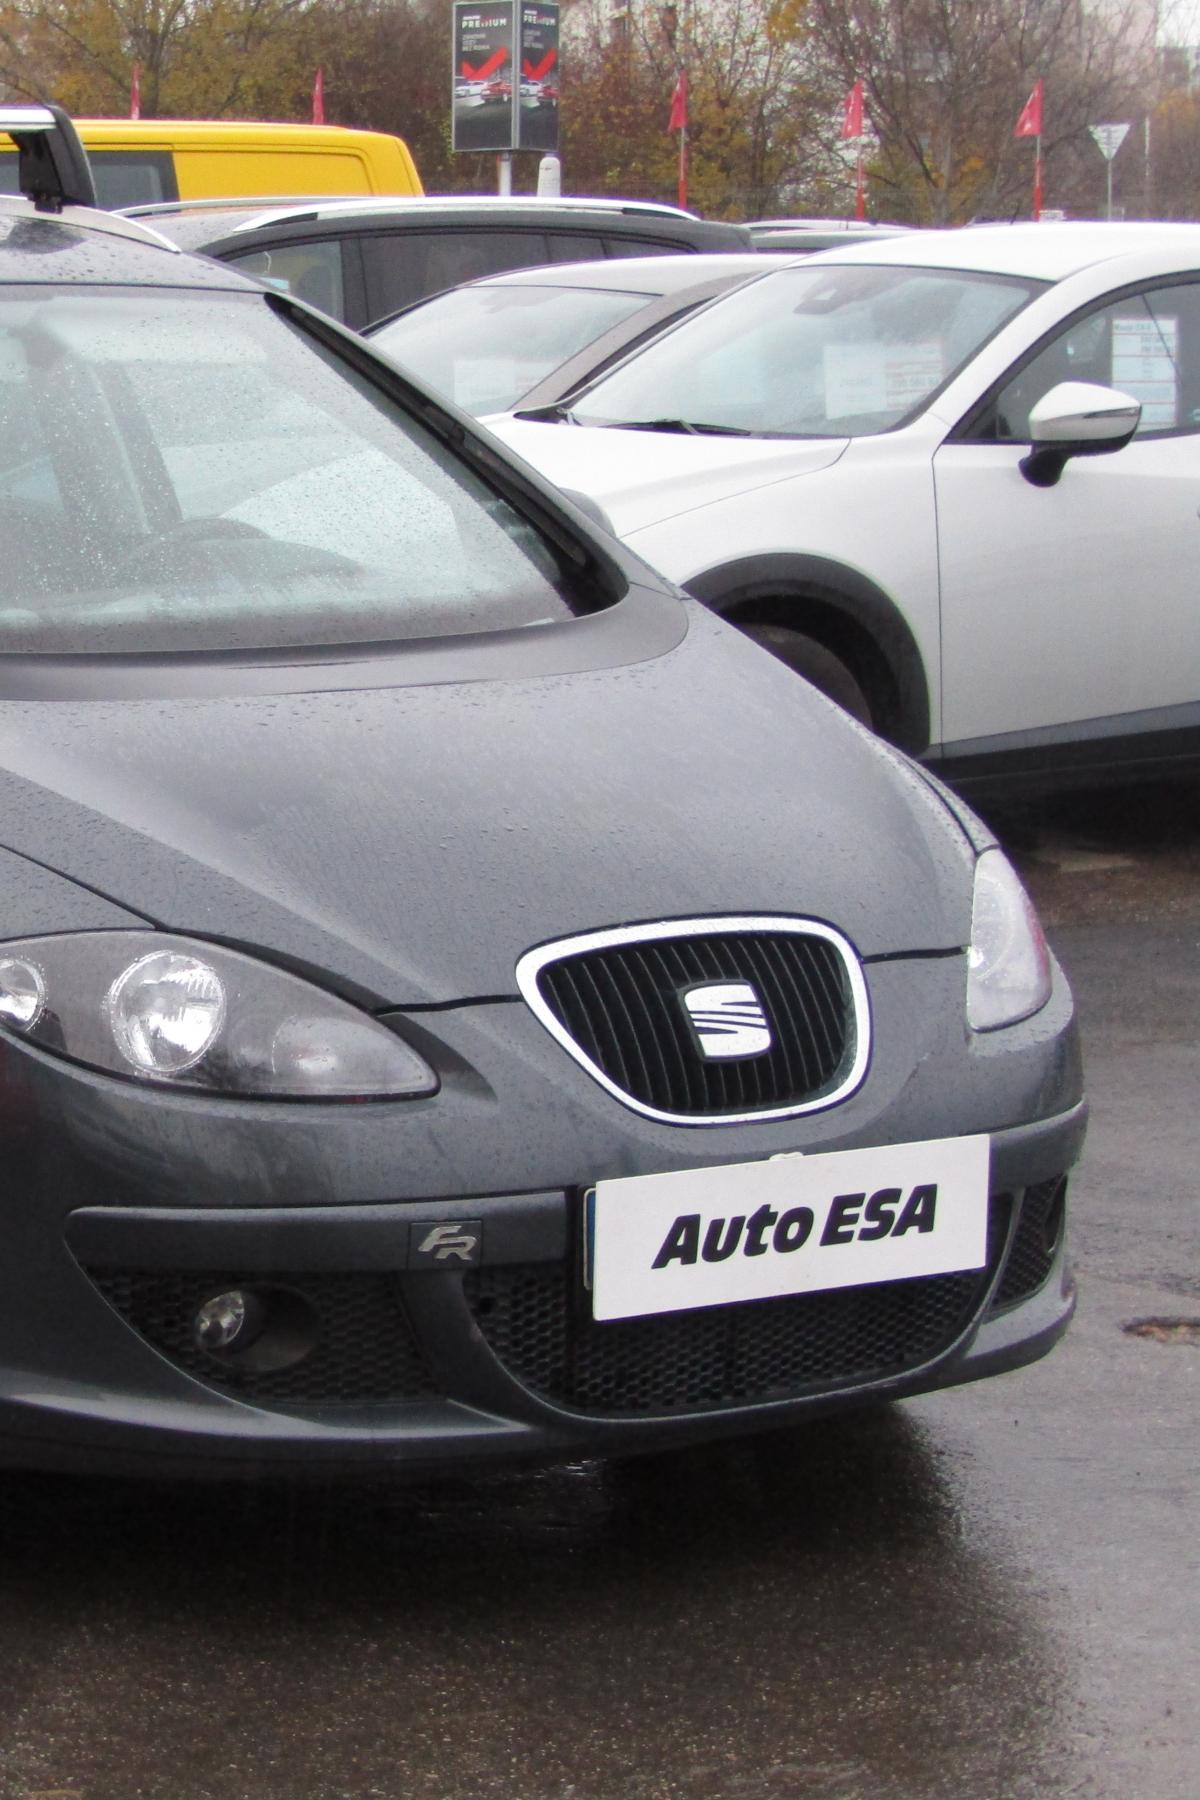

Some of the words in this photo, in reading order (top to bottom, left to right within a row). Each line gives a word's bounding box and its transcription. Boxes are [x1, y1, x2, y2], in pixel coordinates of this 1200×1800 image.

[418, 1226, 477, 1260] FR
[651, 1204, 815, 1270] Auto
[819, 1183, 938, 1247] ESA
